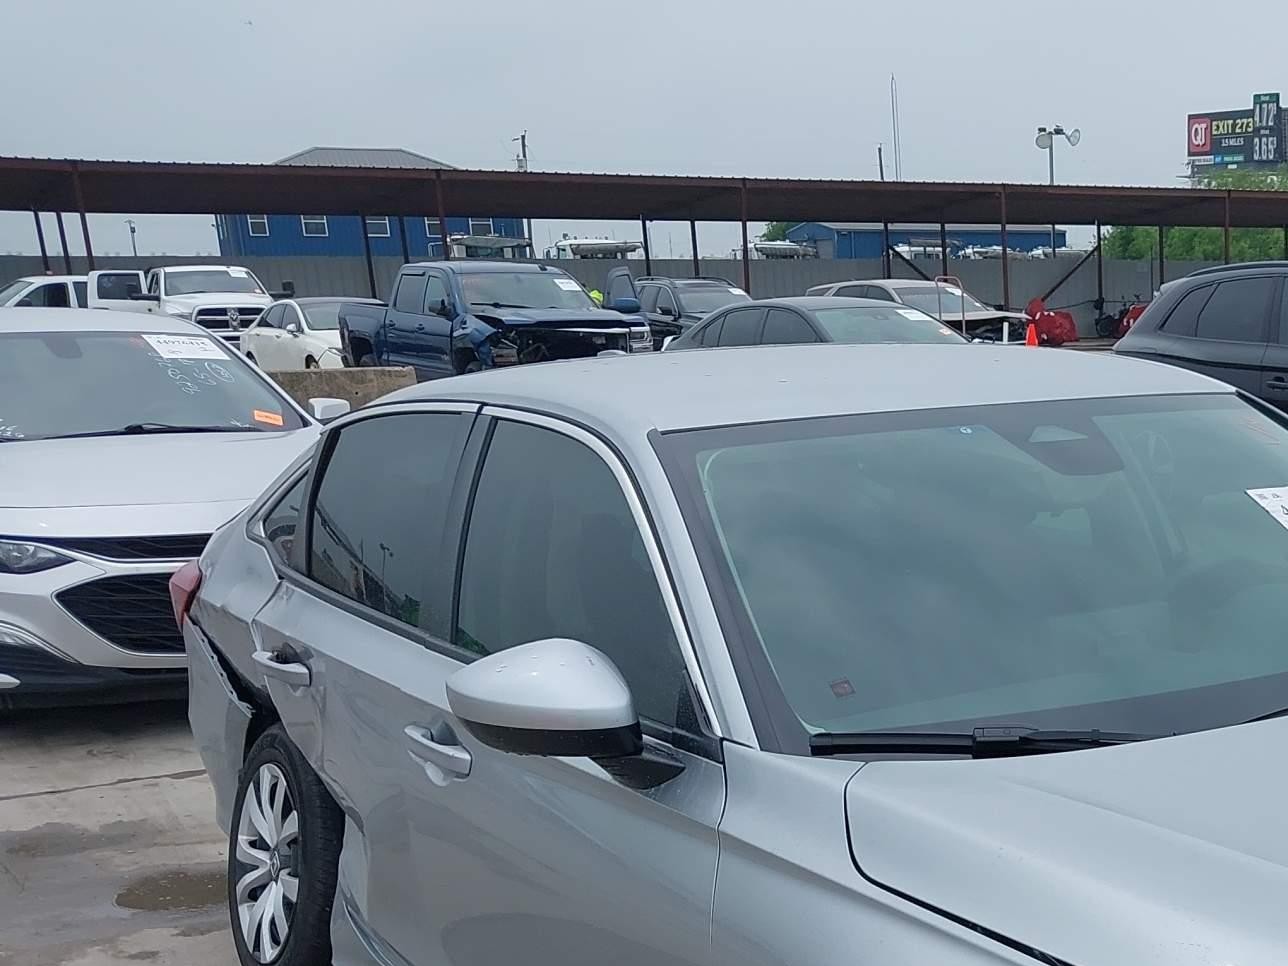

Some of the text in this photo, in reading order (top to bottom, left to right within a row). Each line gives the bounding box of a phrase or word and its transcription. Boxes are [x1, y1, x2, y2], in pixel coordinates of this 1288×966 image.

[1191, 123, 1207, 145] QT
[1212, 117, 1254, 135] EXIT 273
